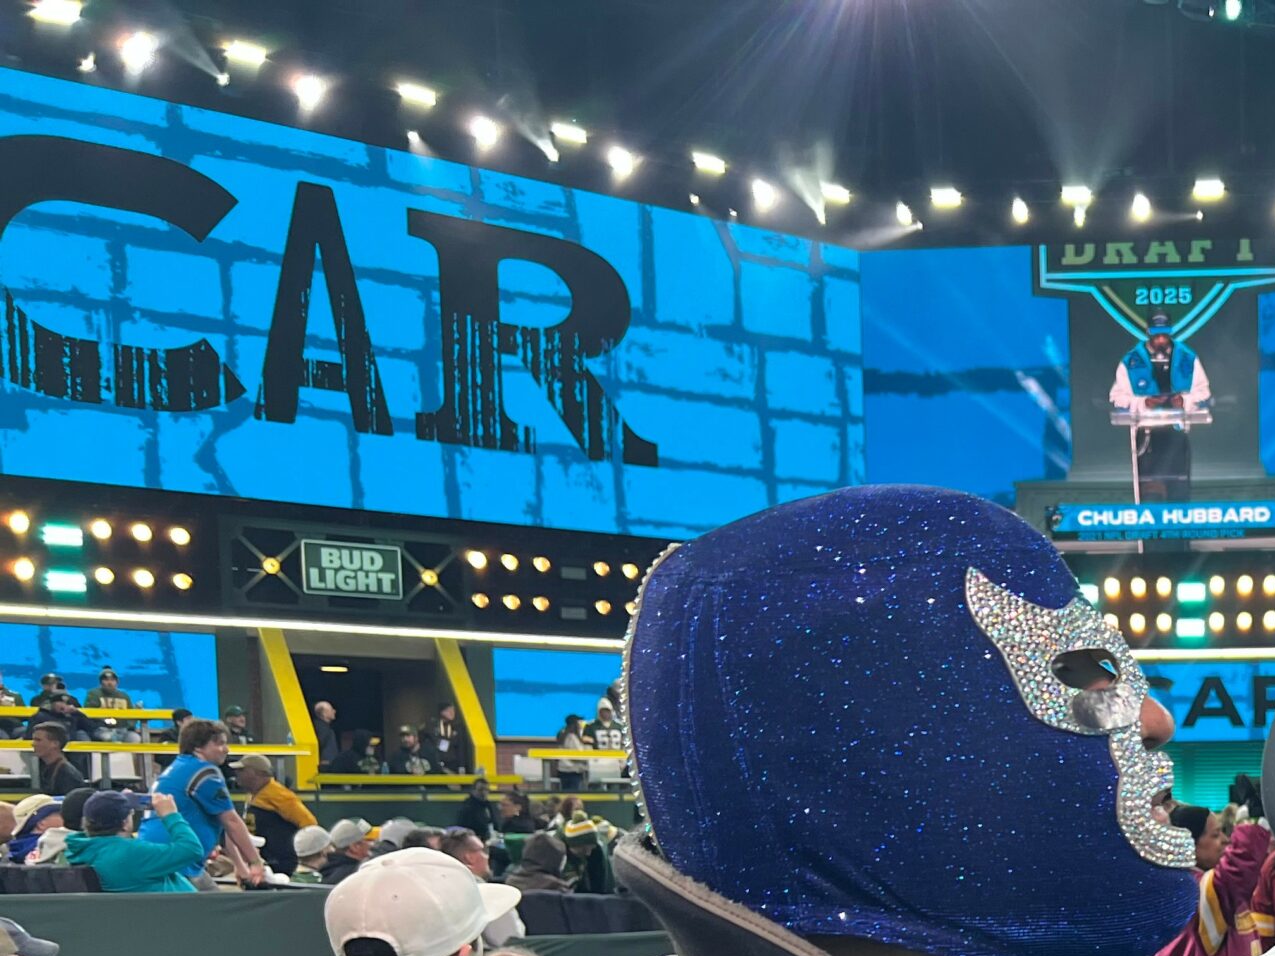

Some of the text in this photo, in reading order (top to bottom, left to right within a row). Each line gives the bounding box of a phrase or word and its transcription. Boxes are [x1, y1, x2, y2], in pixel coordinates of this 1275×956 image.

[0, 134, 659, 468] CAR
[1135, 288, 1192, 306] 2025
[1077, 506, 1271, 526] CHUBA HUBBARD
[320, 547, 383, 572] BUD
[309, 567, 396, 593] LIGHT
